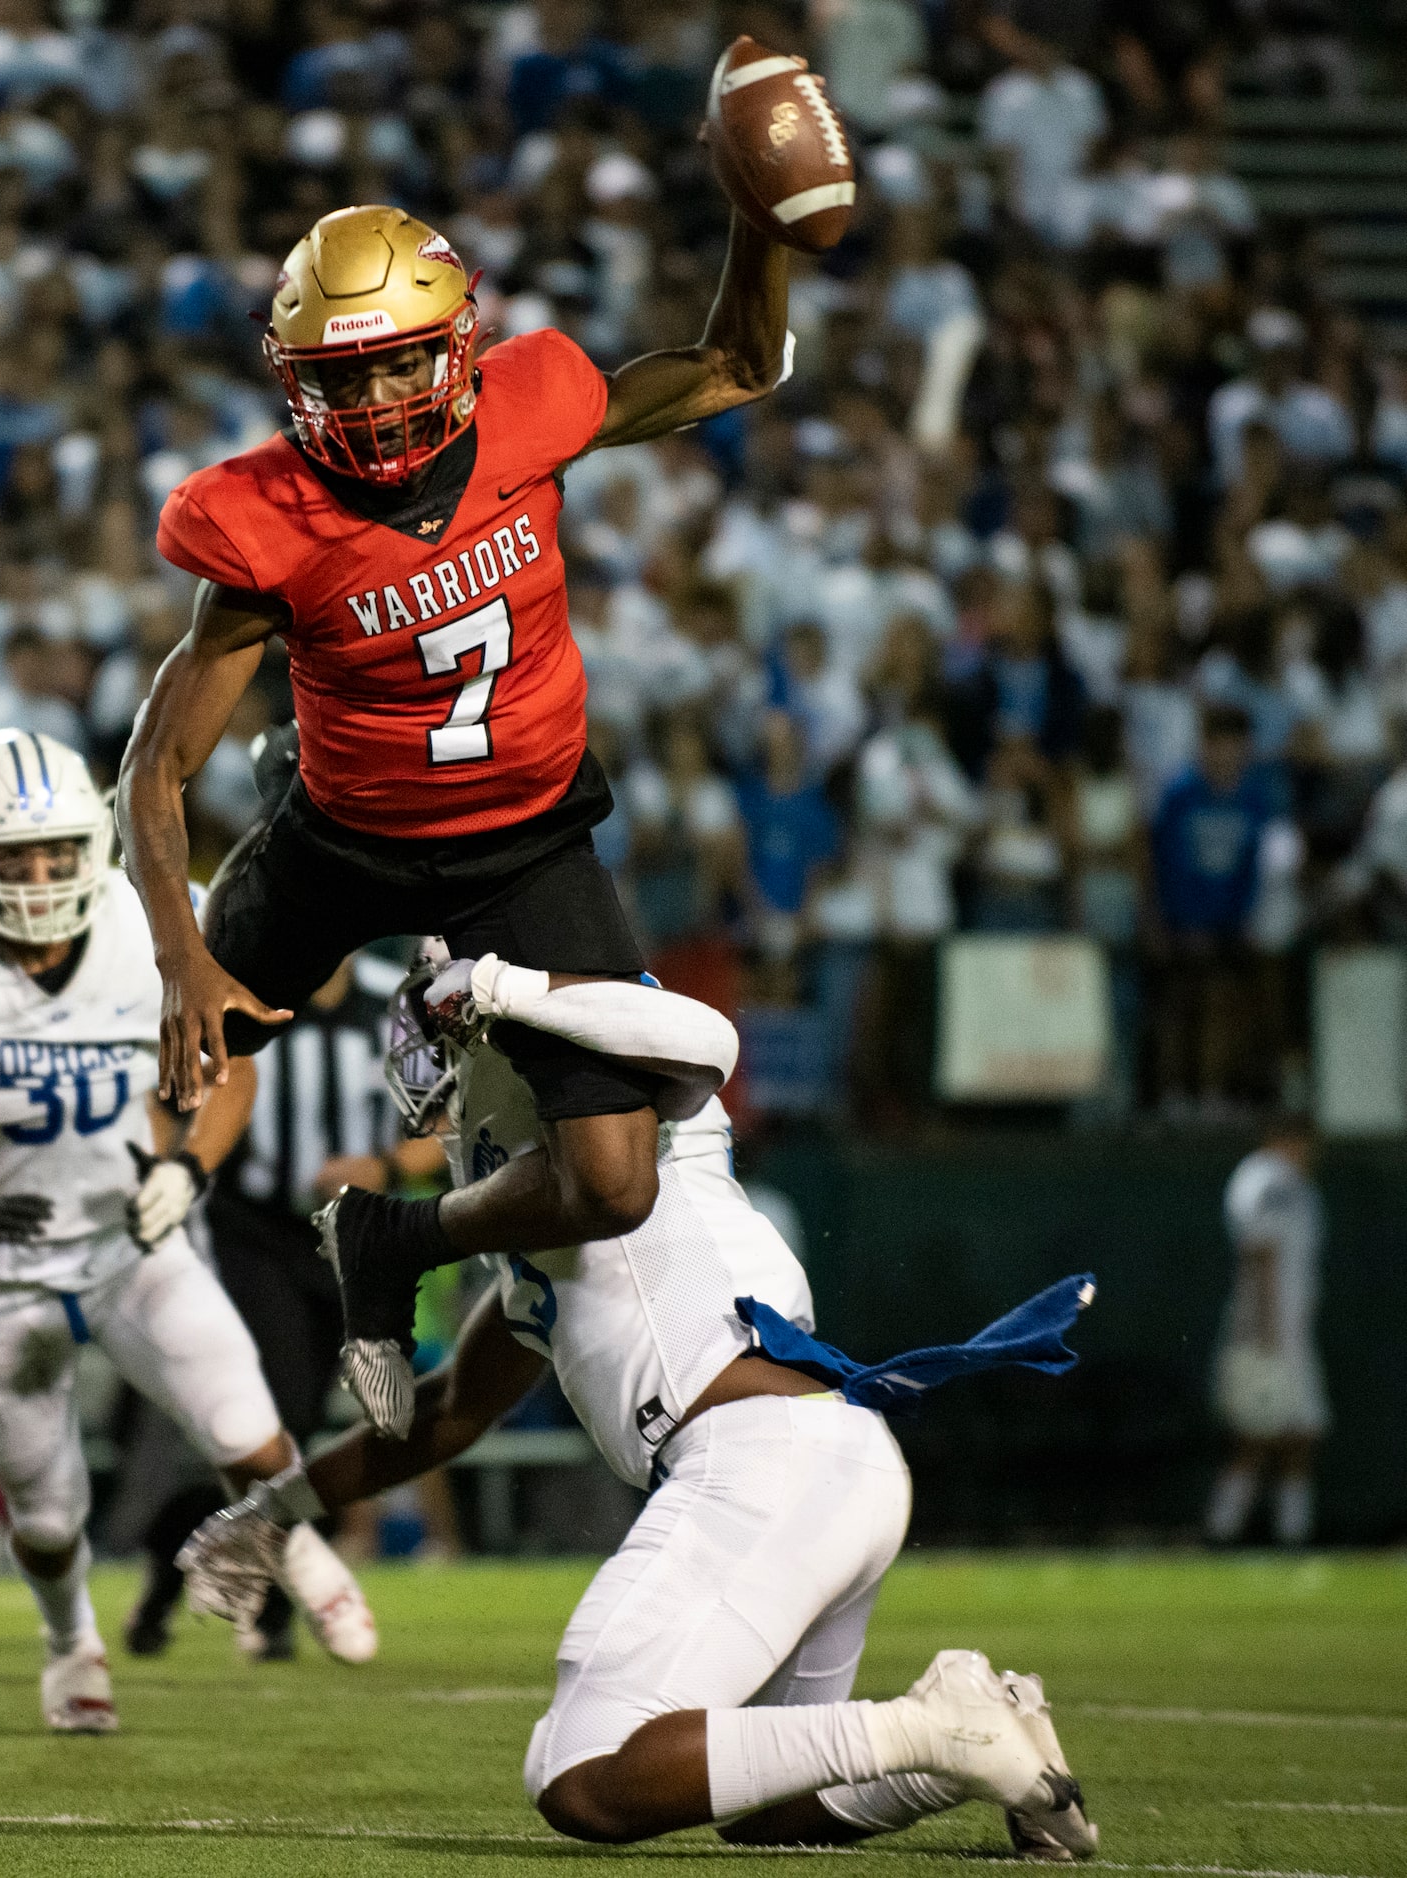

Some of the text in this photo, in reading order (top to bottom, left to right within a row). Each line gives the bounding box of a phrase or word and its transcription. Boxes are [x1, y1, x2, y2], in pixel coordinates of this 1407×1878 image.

[331, 314, 383, 332] Riddell
[347, 513, 541, 637] WARRIORS
[415, 594, 513, 767] 7
[0, 1068, 130, 1144] 30
[642, 1409, 654, 1420] L
